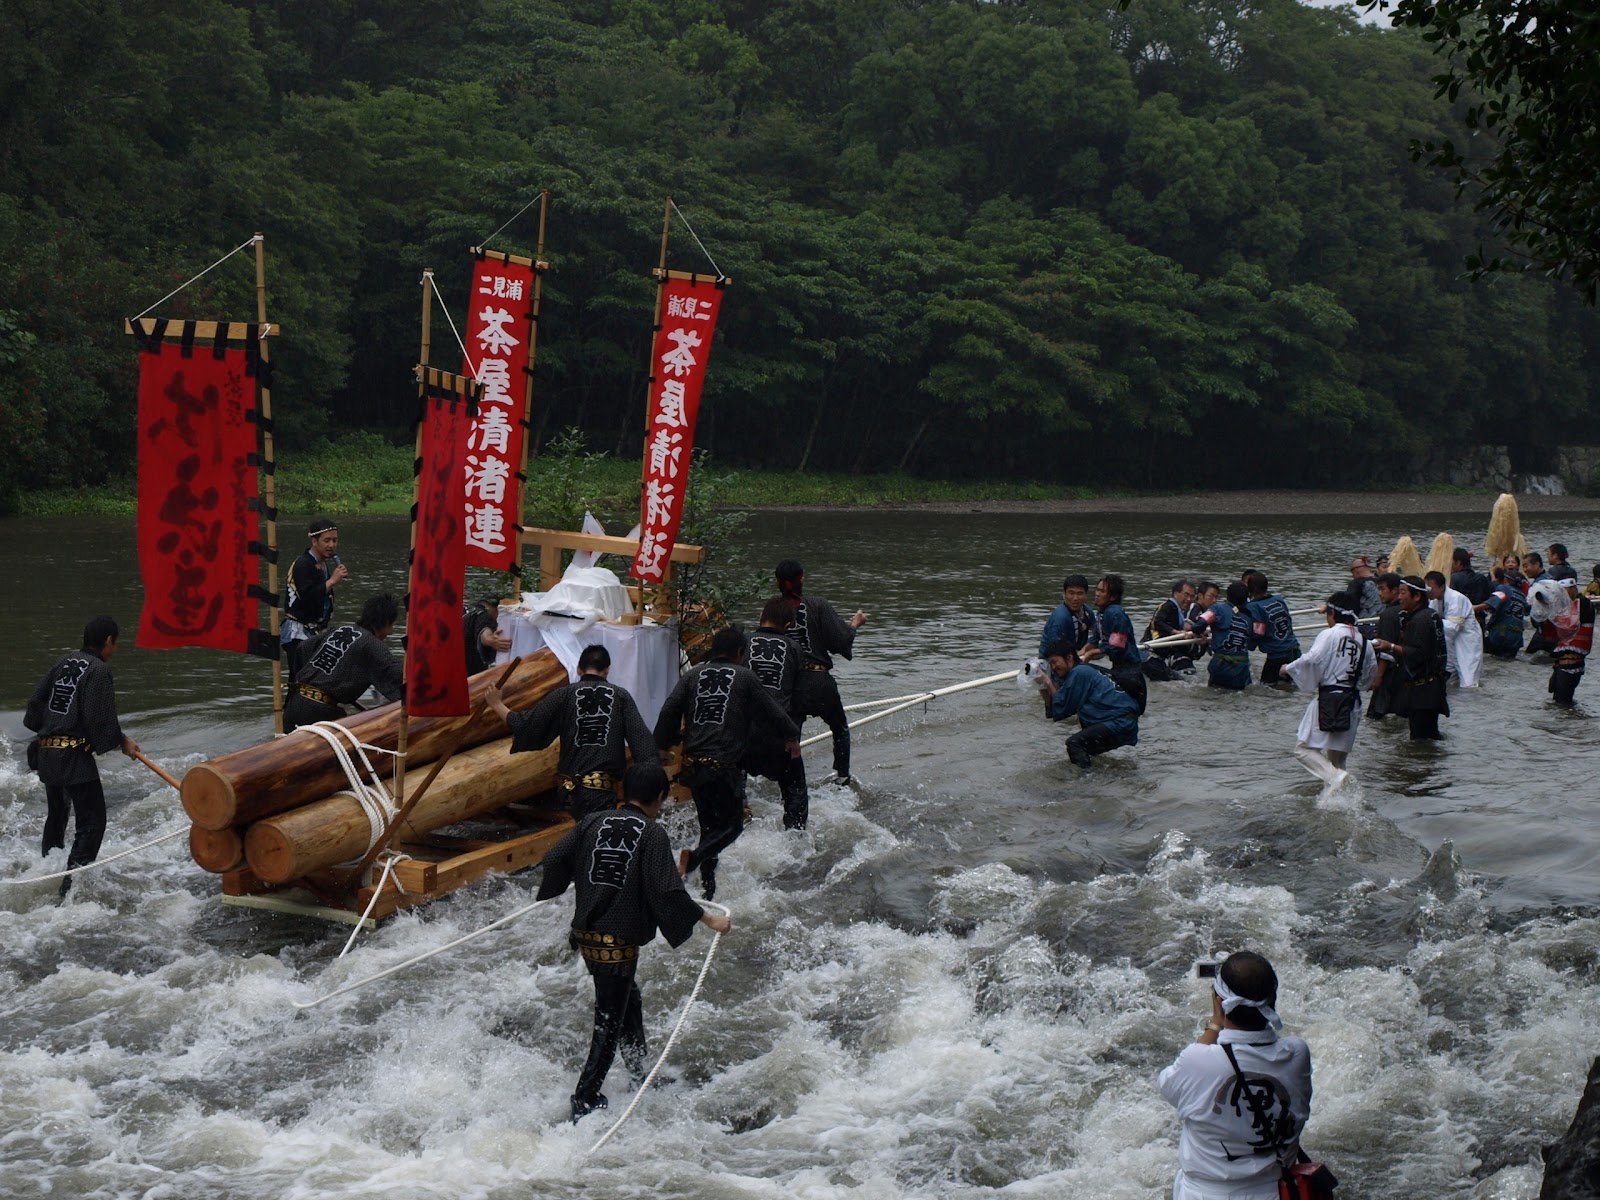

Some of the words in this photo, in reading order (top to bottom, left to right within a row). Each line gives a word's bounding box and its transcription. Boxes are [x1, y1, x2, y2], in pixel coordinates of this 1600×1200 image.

[480, 275, 524, 301] 二見浦
[463, 306, 520, 553] 茶屋清渚連
[310, 625, 362, 675] 茶屋
[747, 635, 786, 690] 茶屋
[48, 658, 89, 715] 茶屋
[693, 667, 736, 726] 茶屋
[574, 686, 615, 748] 茶屋
[588, 816, 647, 889] 茶屋
